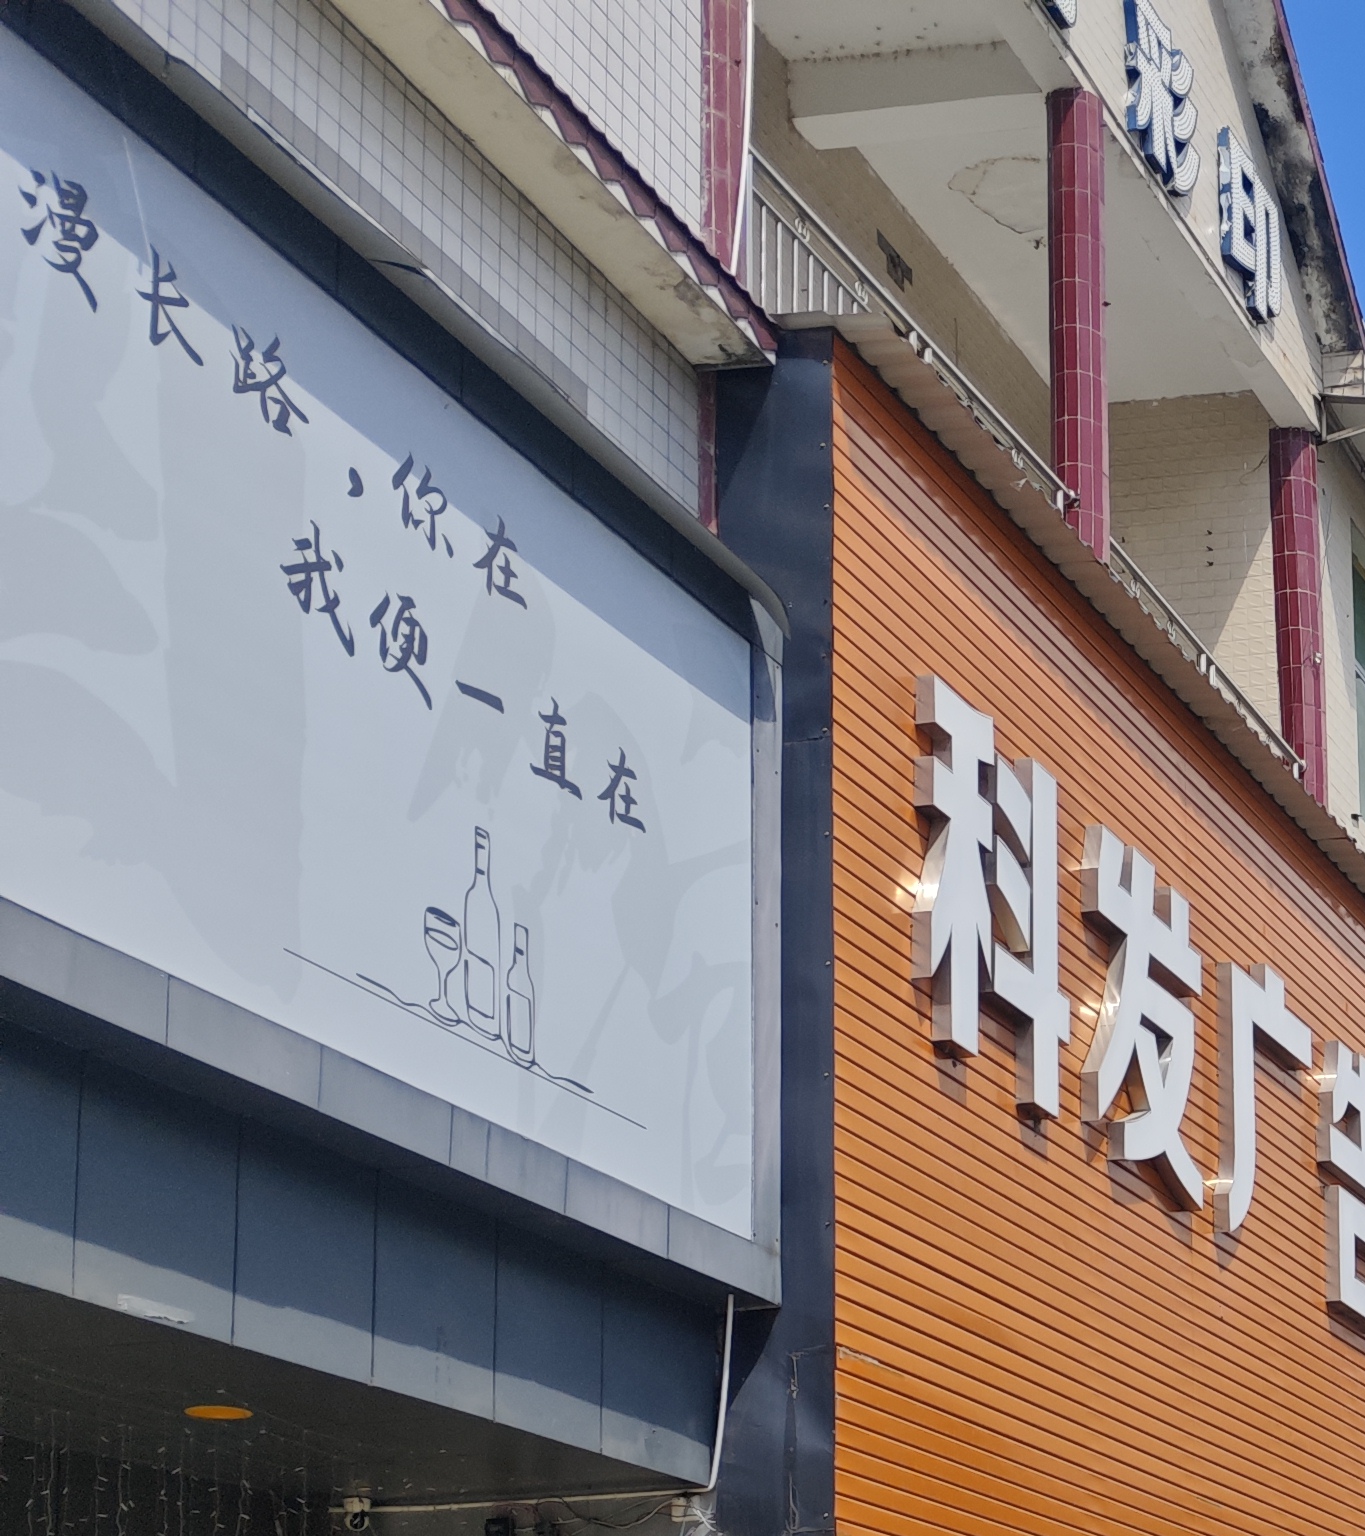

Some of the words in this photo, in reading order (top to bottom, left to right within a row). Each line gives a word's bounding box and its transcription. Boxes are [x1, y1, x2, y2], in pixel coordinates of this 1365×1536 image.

[280, 520, 646, 833] 我便一直在
